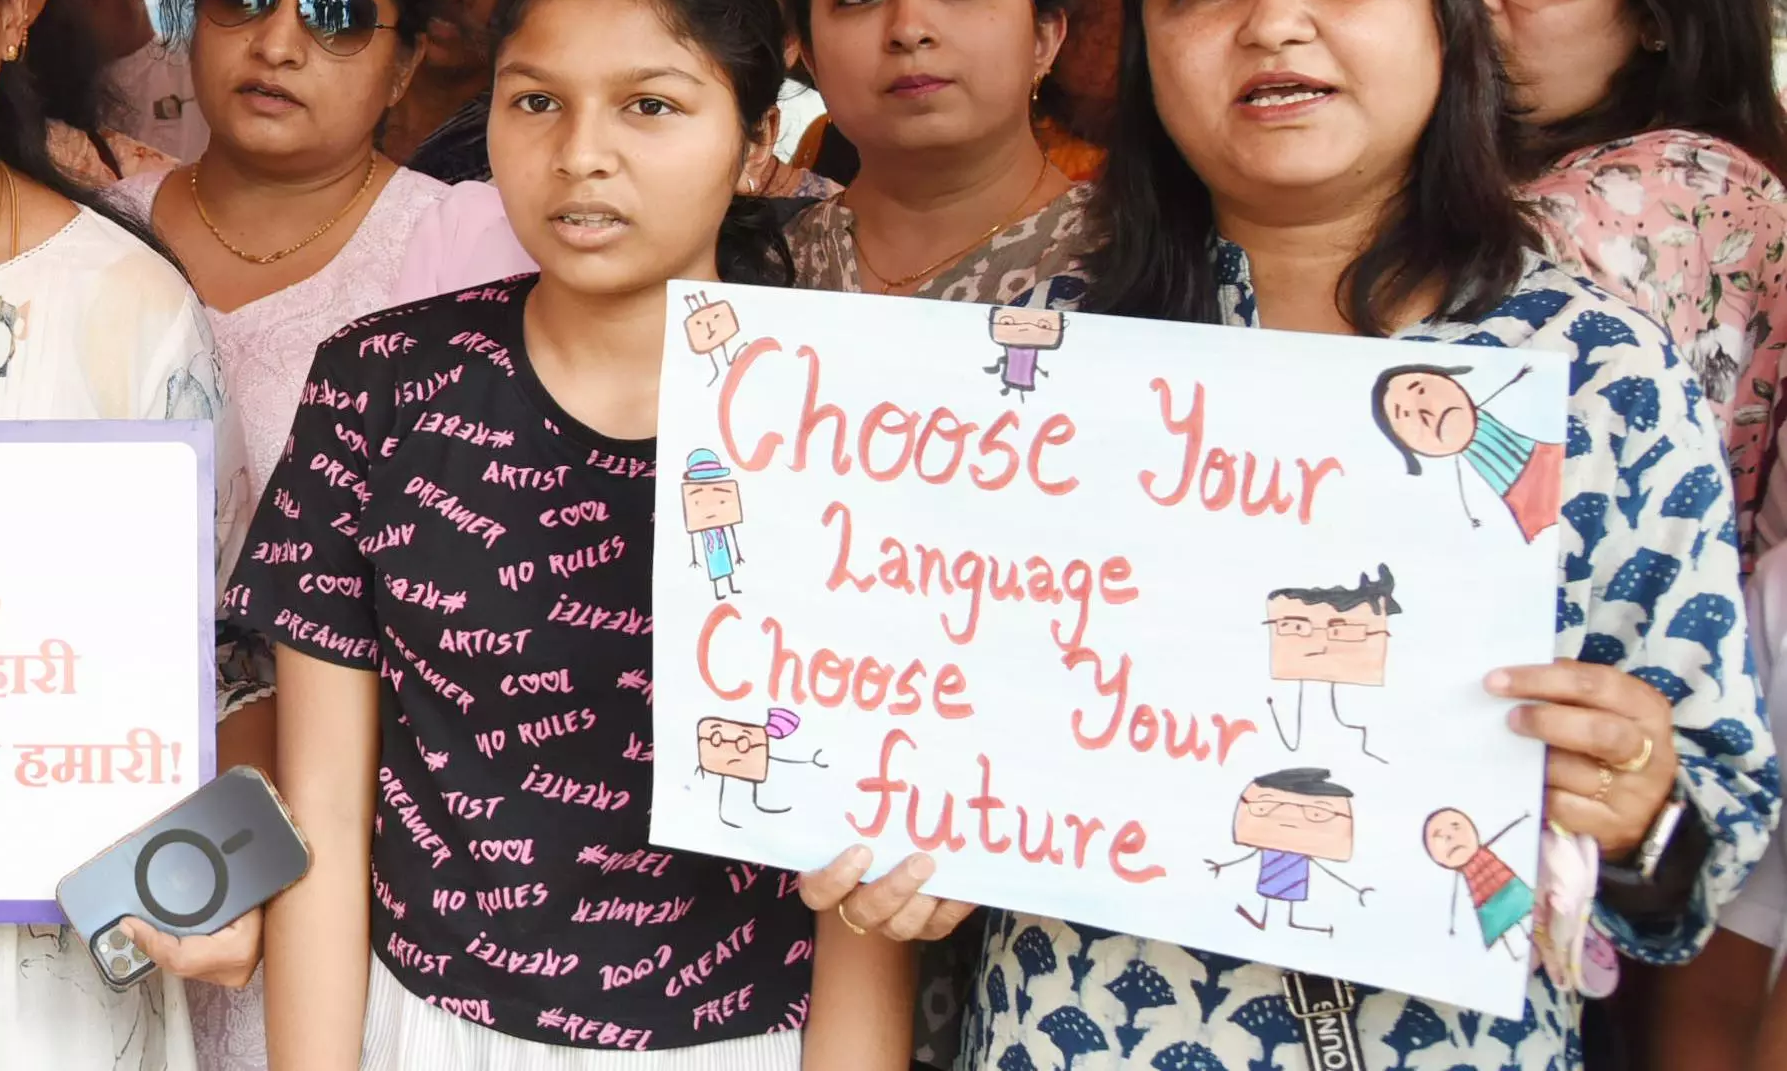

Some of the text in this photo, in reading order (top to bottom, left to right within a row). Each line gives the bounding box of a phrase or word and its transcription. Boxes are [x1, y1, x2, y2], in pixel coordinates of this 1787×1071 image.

[716, 336, 1346, 525] Choose Your
[481, 460, 574, 492] ARTIST
[403, 476, 508, 550] DREAMER
[547, 534, 626, 579] RULES
[819, 500, 1141, 654] Language
[438, 627, 533, 658] ARTIST
[695, 602, 1258, 768] Choose Your
[516, 707, 597, 748] RULES
[12, 725, 183, 787] हमारी!
[378, 765, 453, 870] DREAMER
[476, 881, 549, 917] RULES
[386, 931, 453, 977] ARTIST
[664, 918, 757, 998] CREATE
[534, 1004, 654, 1053] #REBEL
[692, 983, 755, 1032] FREE
